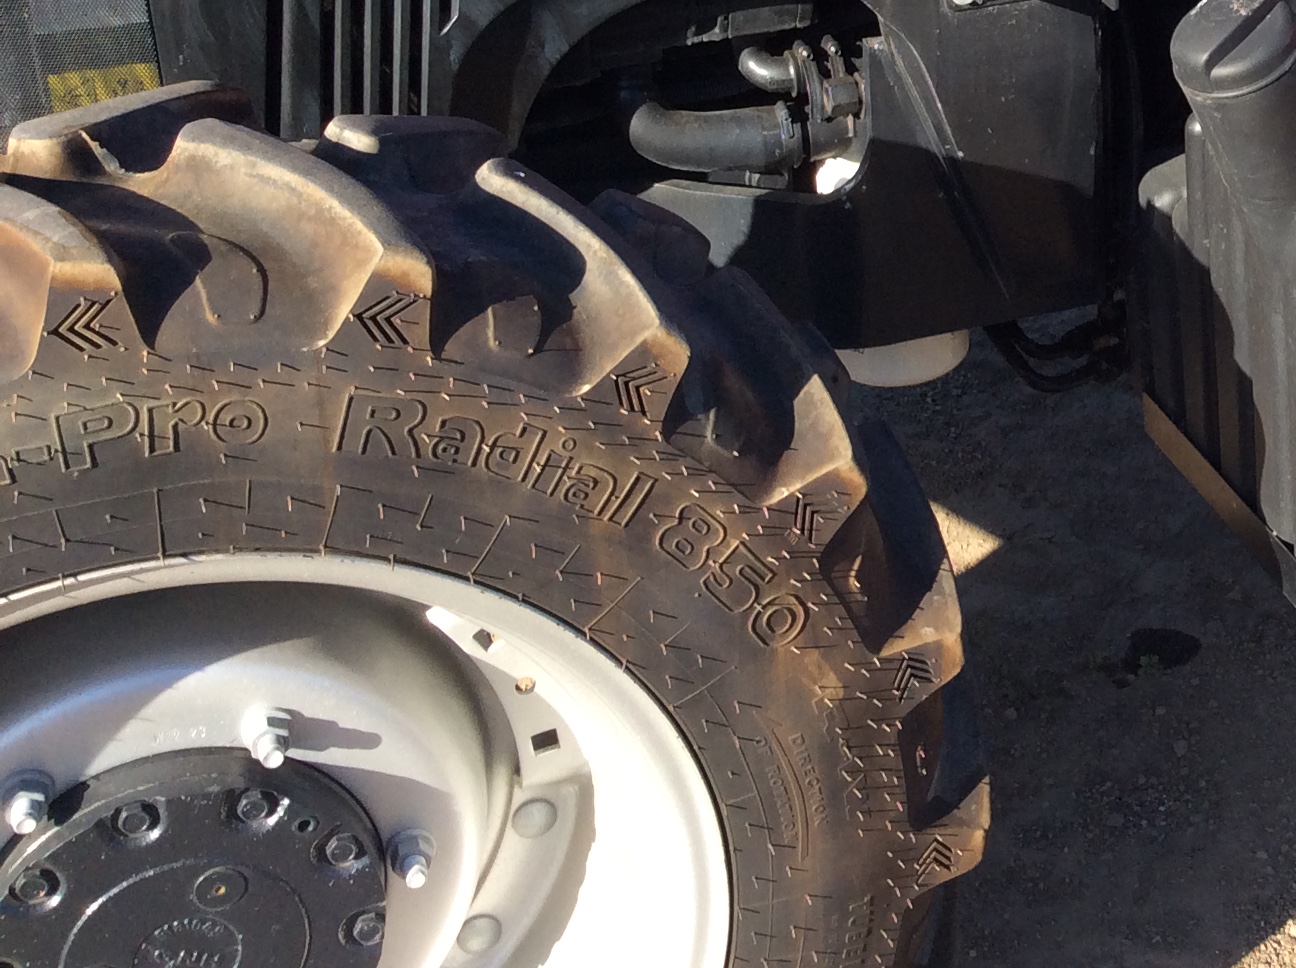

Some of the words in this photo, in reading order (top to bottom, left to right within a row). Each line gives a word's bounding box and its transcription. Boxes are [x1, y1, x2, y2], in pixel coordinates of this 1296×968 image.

[0, 397, 269, 485] -Pro
[331, 392, 659, 529] Radial
[656, 501, 811, 648] 850
[788, 732, 830, 828] DIRECTION
